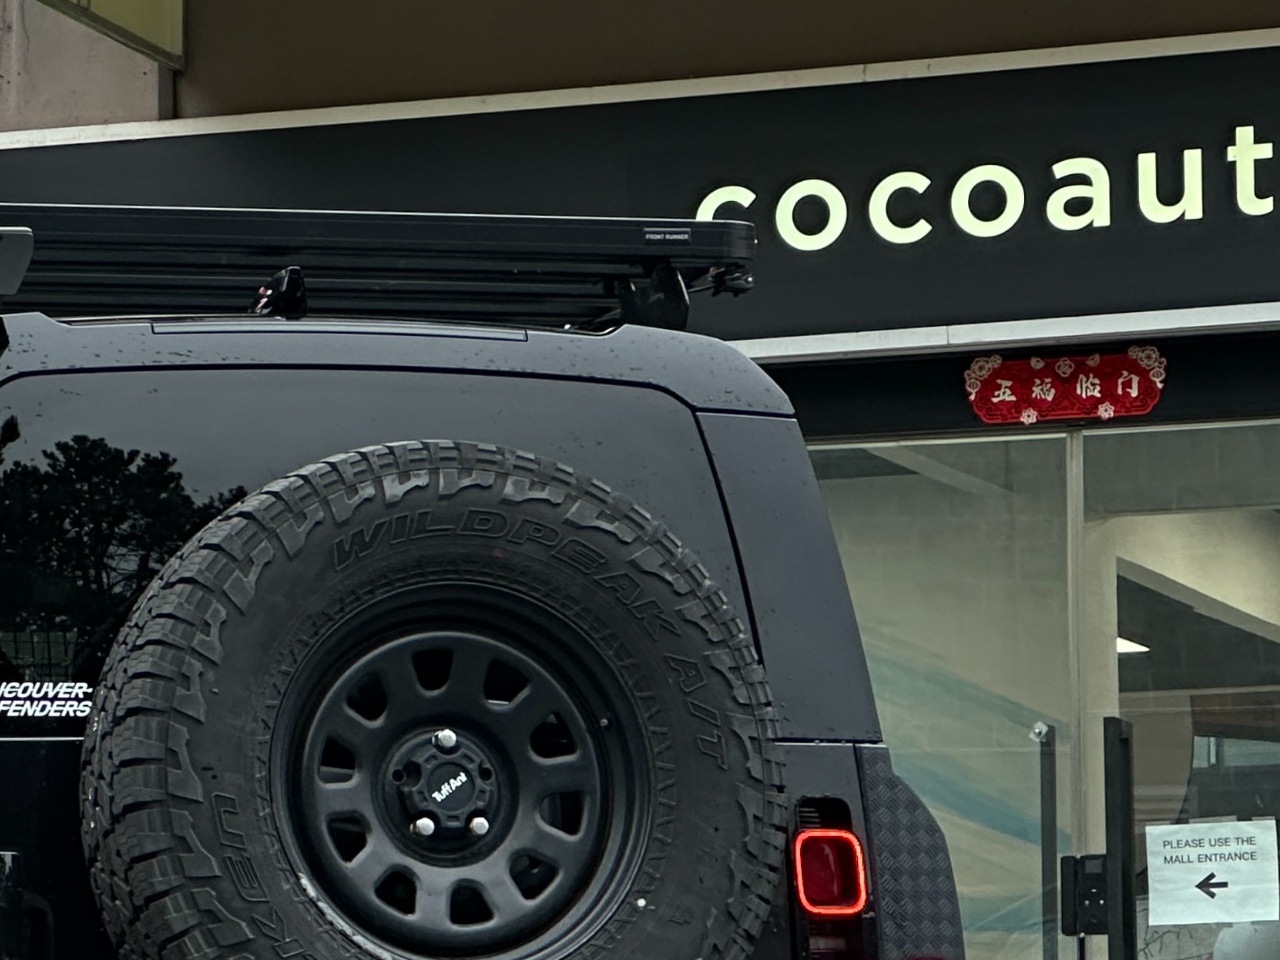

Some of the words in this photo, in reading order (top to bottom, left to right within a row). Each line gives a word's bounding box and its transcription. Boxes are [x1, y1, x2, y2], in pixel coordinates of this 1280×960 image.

[990, 370, 1141, 404] 五福临门
[331, 507, 682, 642] WILDPEAK
[1163, 839, 1206, 849] PLEASE
[1209, 837, 1232, 847] USE
[1234, 835, 1257, 846] THE
[1164, 854, 1194, 864] MALL
[1197, 852, 1258, 863] ENTRANCE
